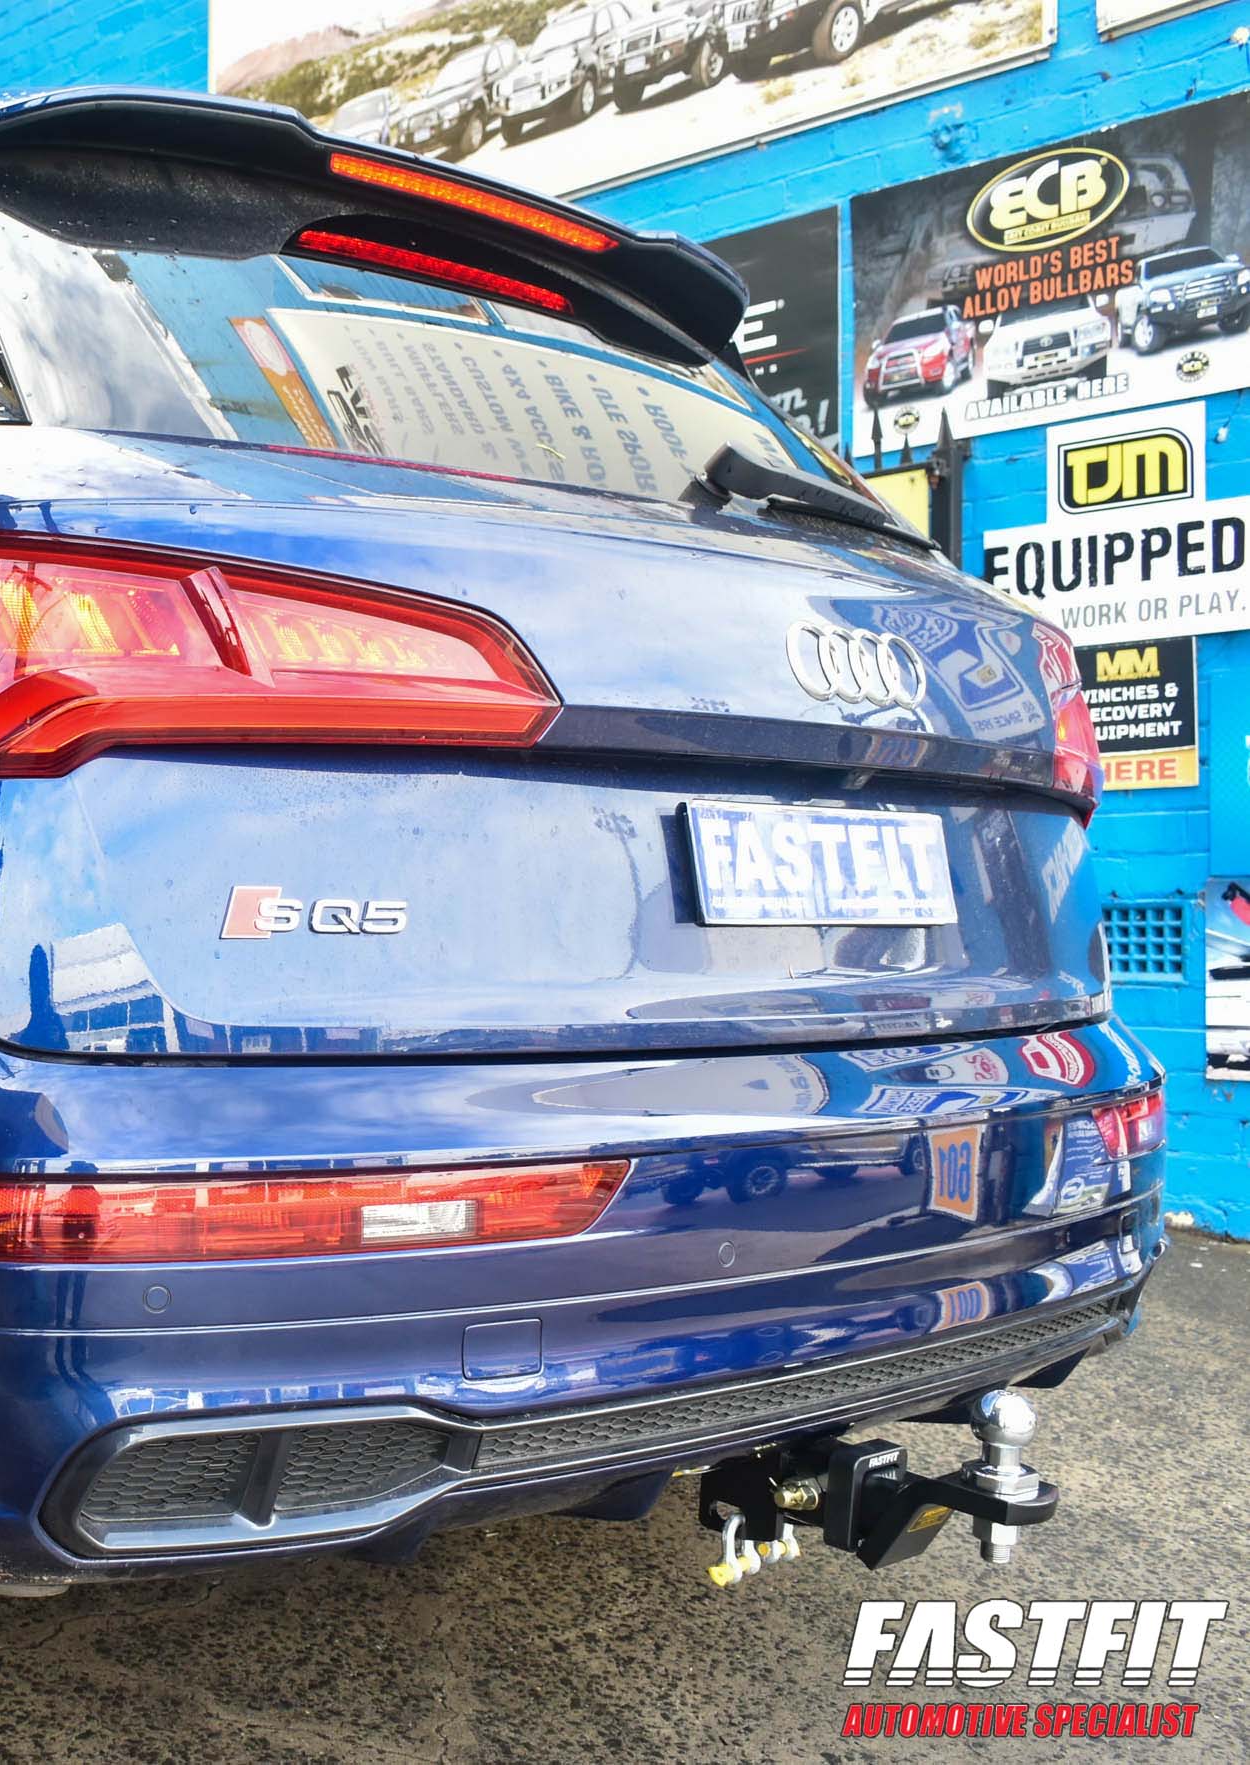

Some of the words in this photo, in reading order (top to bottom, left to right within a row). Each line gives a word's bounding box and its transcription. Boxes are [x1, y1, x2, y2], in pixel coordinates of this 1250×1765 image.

[989, 159, 1107, 230] ECB
[976, 250, 1062, 291] WORLD'S
[1069, 236, 1121, 270] BEST
[963, 285, 1022, 320] ALLOY
[1029, 259, 1135, 305] BULLBARS
[965, 384, 1068, 421] AVAILABLE
[1076, 373, 1130, 400] HERE
[1066, 436, 1185, 505] TJM
[984, 516, 1246, 600] EQUIPPED
[1062, 601, 1127, 630] WORK
[1138, 597, 1168, 621] OR
[1179, 589, 1246, 618] PLAY.
[1090, 702, 1175, 722] ECOVERY
[1164, 682, 1179, 698] &
[1095, 720, 1182, 741] UIPMENT
[700, 818, 938, 900] FASTFIT
[869, 1451, 900, 1468] FASTFIT
